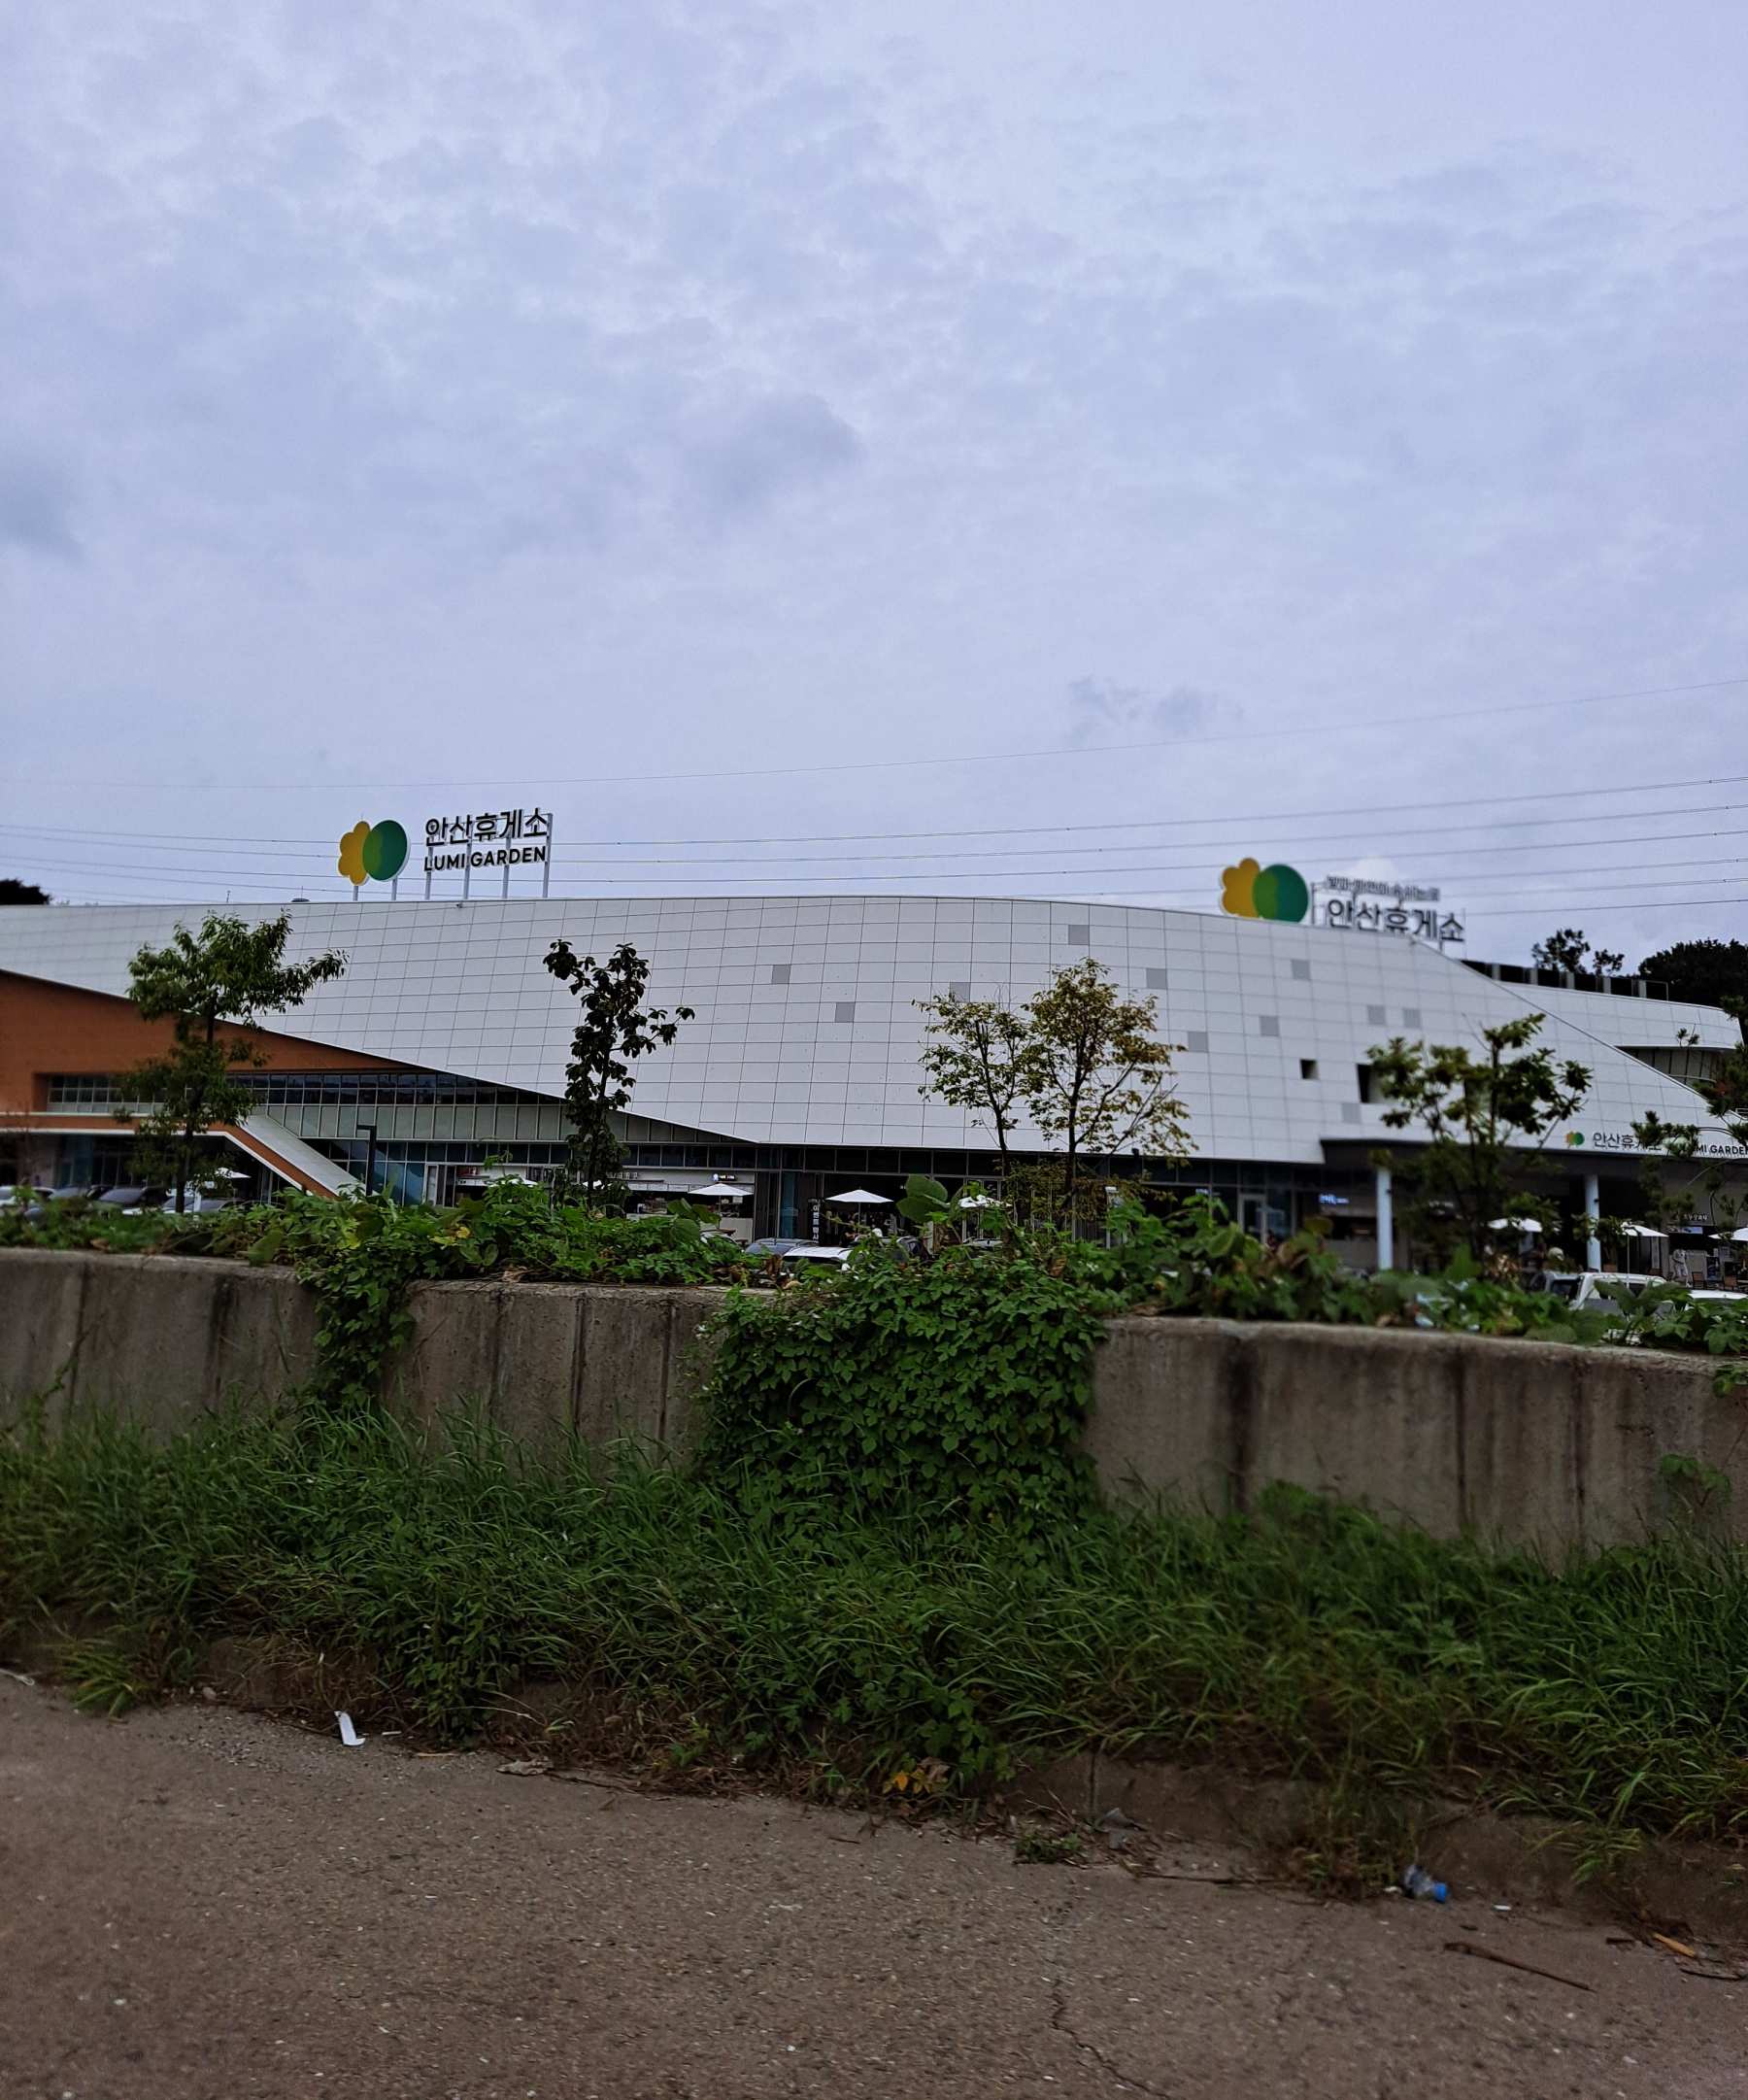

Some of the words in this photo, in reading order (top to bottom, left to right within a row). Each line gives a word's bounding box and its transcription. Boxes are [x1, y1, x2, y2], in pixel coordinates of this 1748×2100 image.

[425, 807, 548, 847] 안산휴게소
[424, 855, 465, 871] LUMI
[471, 846, 547, 867] GARDEN
[1328, 899, 1464, 942] 안산휴게소
[1593, 1133, 1662, 1151] 안산휴
